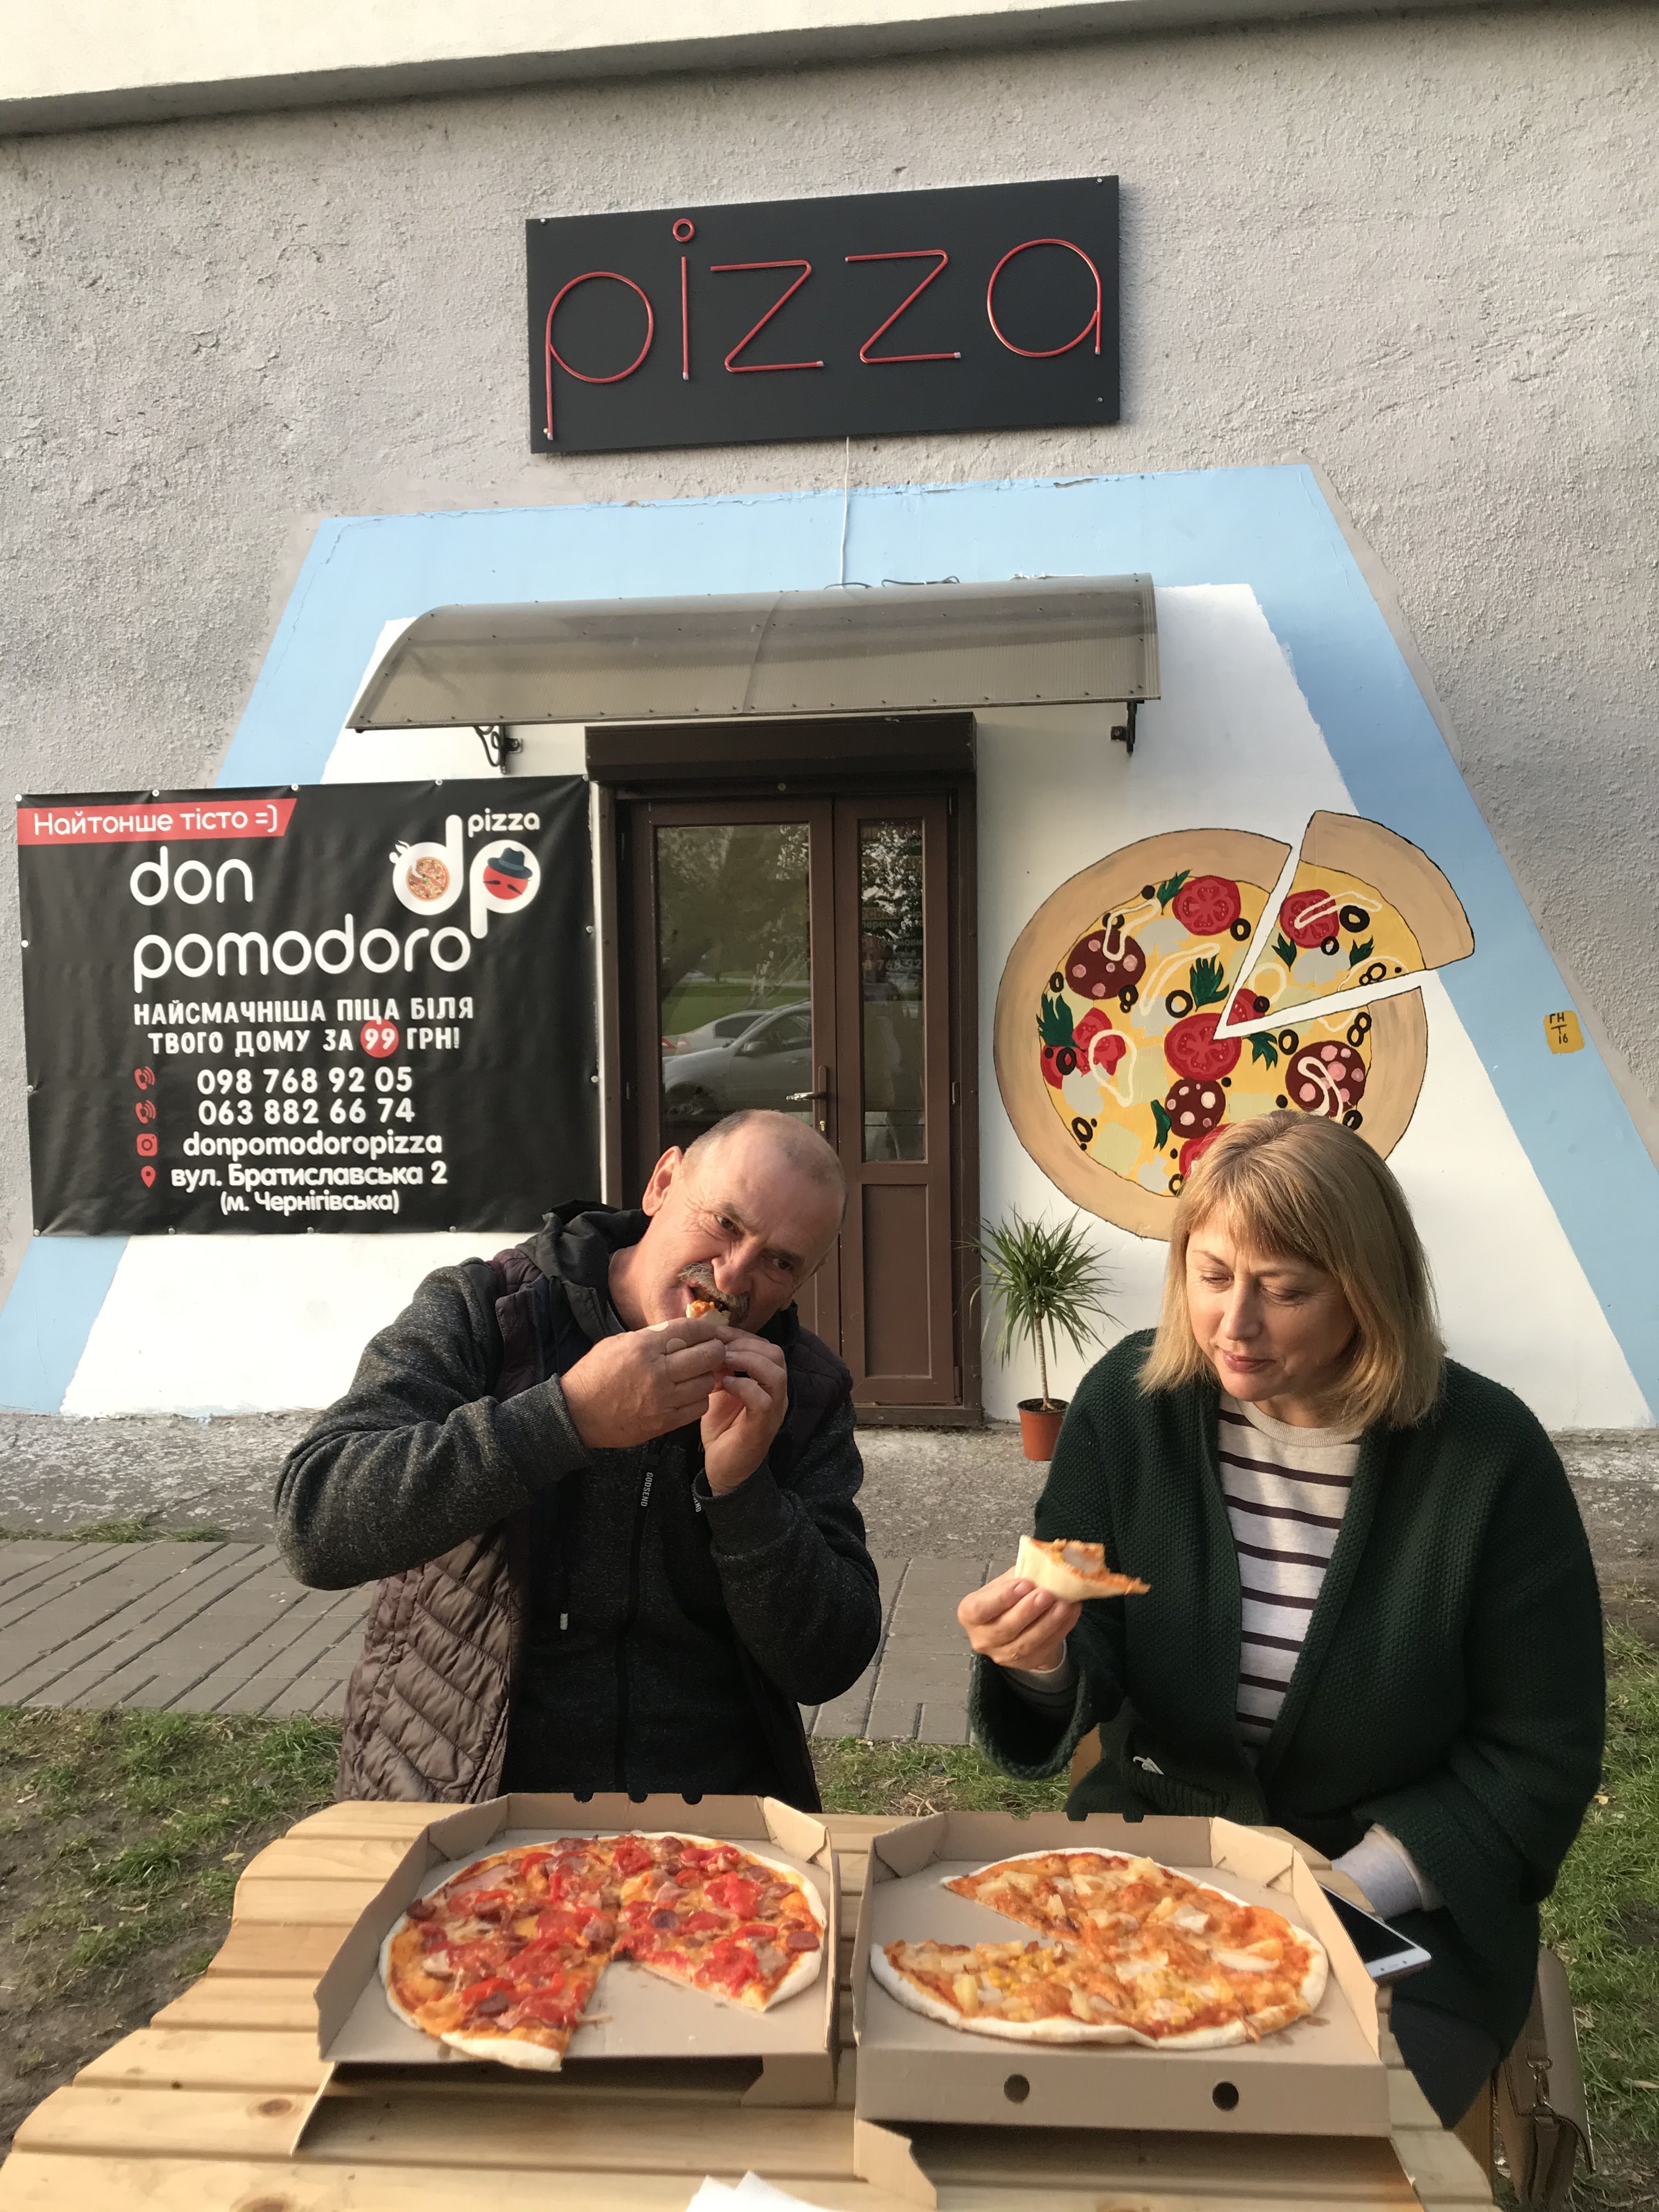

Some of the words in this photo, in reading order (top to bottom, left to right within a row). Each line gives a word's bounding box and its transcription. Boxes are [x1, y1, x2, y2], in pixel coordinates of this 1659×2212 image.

[545, 218, 1102, 440] pizza
[34, 810, 173, 836] Найтонше
[179, 808, 248, 830] тісто
[468, 808, 540, 838] pizza
[129, 845, 253, 906] don
[133, 913, 471, 994] pomodoro
[134, 1000, 326, 1025] НАЙСМАЧНІША
[337, 998, 400, 1024] ПІЦА
[411, 997, 473, 1019] БІЛЯ
[148, 1032, 223, 1054] ТВОГО
[235, 1030, 311, 1057] ДОМУ
[323, 1029, 354, 1051] ЗА
[365, 1028, 396, 1050] 99
[407, 1027, 460, 1050] ГРН!
[197, 1068, 252, 1094] 098
[263, 1068, 318, 1093] 768
[329, 1066, 365, 1093] 92
[375, 1066, 412, 1092] 05
[198, 1099, 253, 1125] 063
[264, 1098, 319, 1125] 882
[330, 1098, 366, 1124] 66
[377, 1097, 415, 1123] 74
[183, 1129, 443, 1160] donpomodoropizza
[171, 1169, 222, 1193] вул.
[228, 1163, 423, 1191] Братиславська
[431, 1160, 448, 1184] 2
[221, 1192, 250, 1216] (м.
[254, 1189, 399, 1216] Чернігівська)
[641, 1472, 653, 1507] GODSEND
